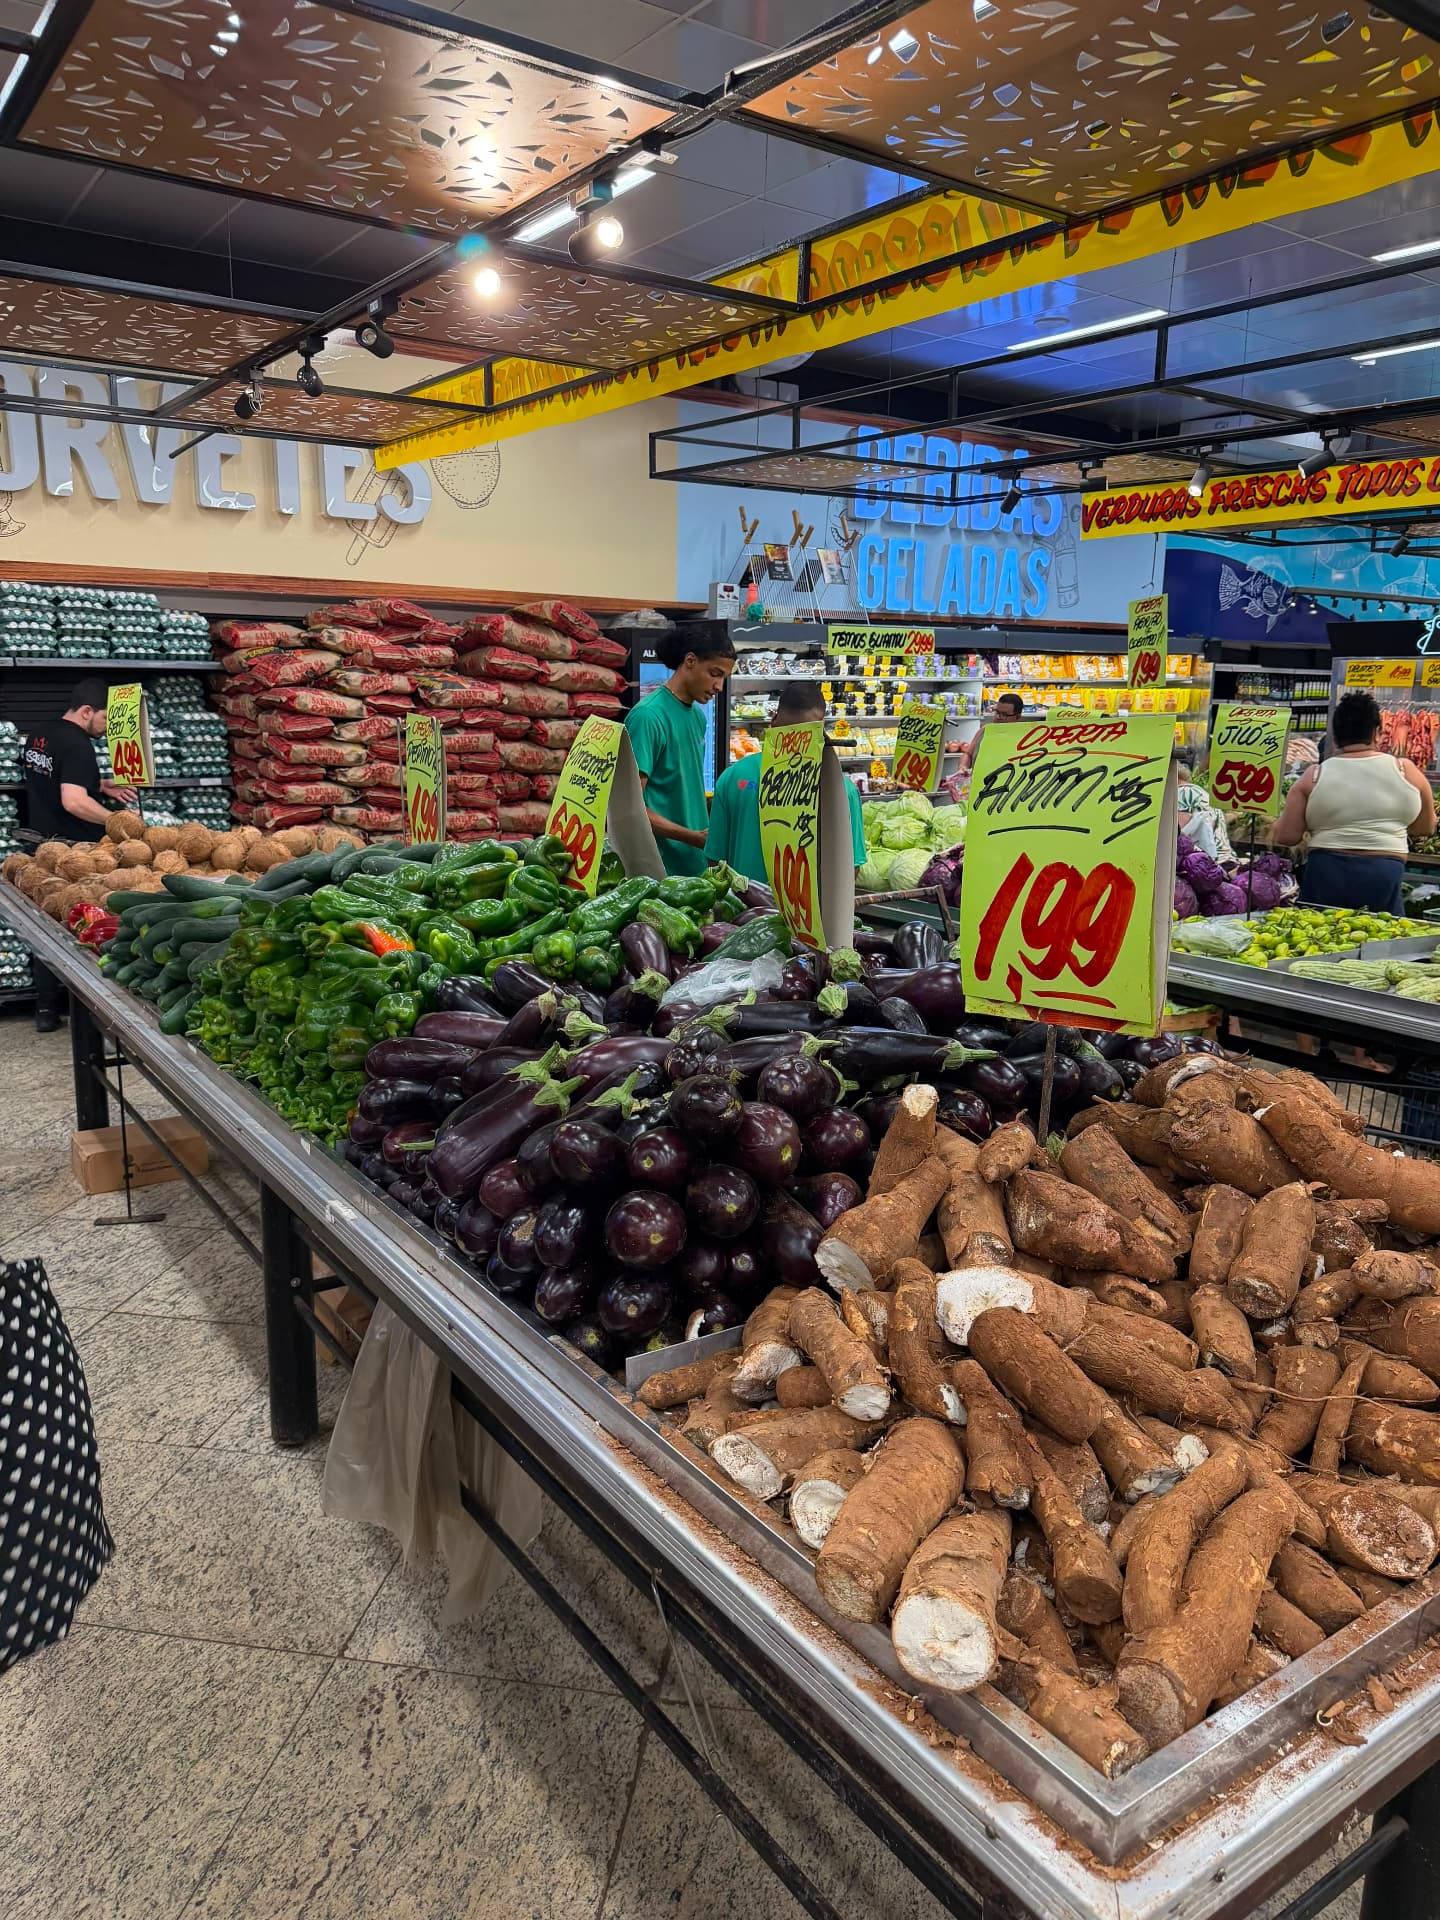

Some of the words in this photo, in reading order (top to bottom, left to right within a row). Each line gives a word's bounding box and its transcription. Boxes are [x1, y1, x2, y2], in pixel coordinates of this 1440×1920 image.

[855, 425, 1063, 537] BEBIDAS
[1081, 486, 1200, 533] VERDURAS
[1208, 469, 1332, 515] FRESCAS
[1336, 458, 1425, 505] TODOS
[857, 534, 1050, 617] GELADAS
[113, 740, 144, 784] 4,99
[1017, 721, 1127, 751] OFERTA
[1212, 759, 1275, 809] 5,99
[974, 851, 1137, 1002] 1,99
